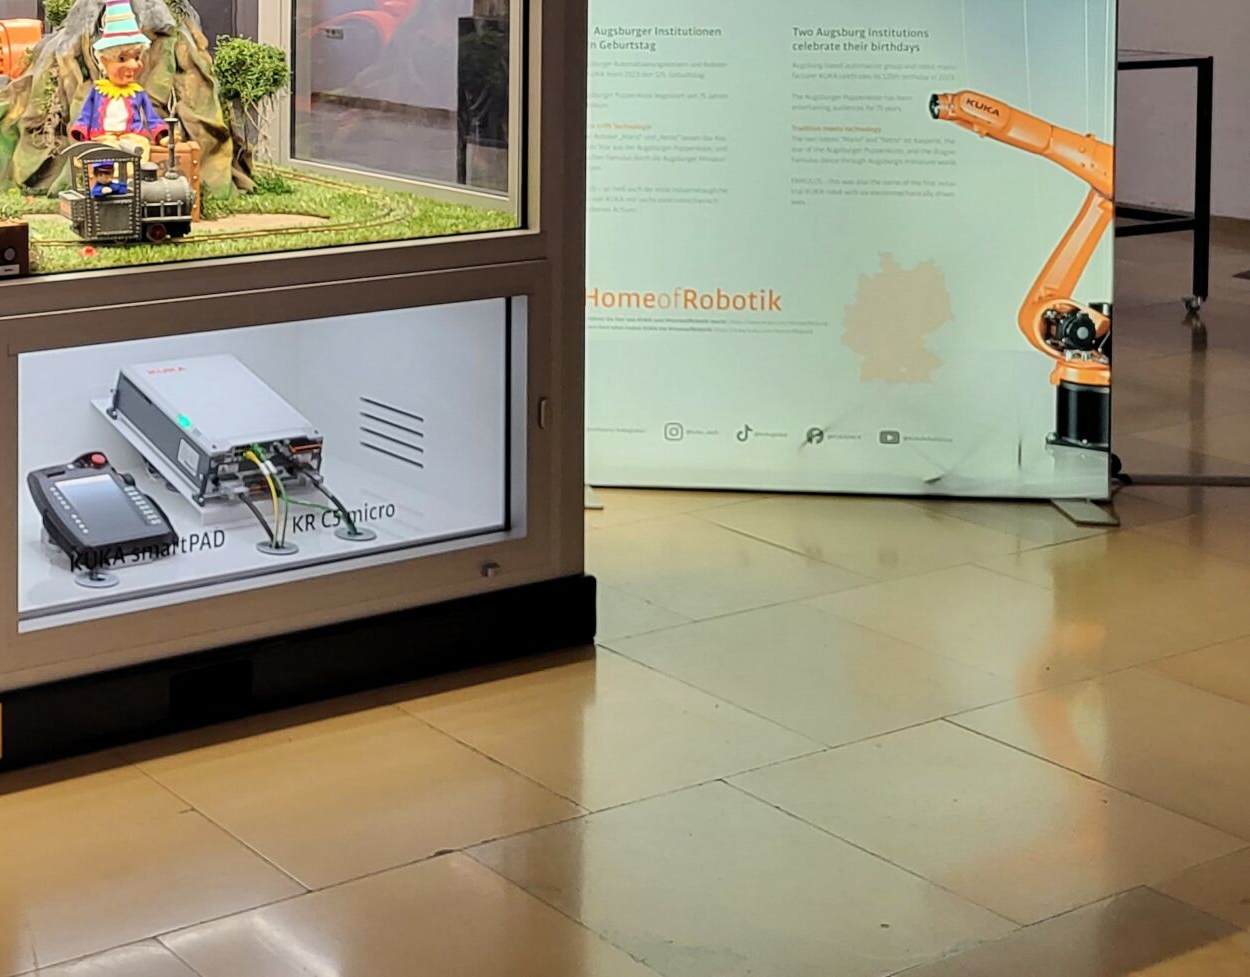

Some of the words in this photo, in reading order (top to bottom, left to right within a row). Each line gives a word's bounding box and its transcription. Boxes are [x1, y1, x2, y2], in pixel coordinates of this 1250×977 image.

[593, 26, 652, 38] Augsburger
[654, 26, 722, 37] Institutionen
[792, 27, 814, 38] Two
[816, 27, 866, 39] Augsburg
[599, 40, 657, 52] Geburtstag
[791, 41, 841, 51] celebrate
[843, 41, 868, 51] their
[870, 42, 921, 54] birthdays
[965, 97, 1000, 117] KUKA
[292, 513, 316, 534] KR
[347, 502, 396, 524] micro
[70, 545, 126, 573] KUKA
[131, 529, 226, 563] smartPAD
